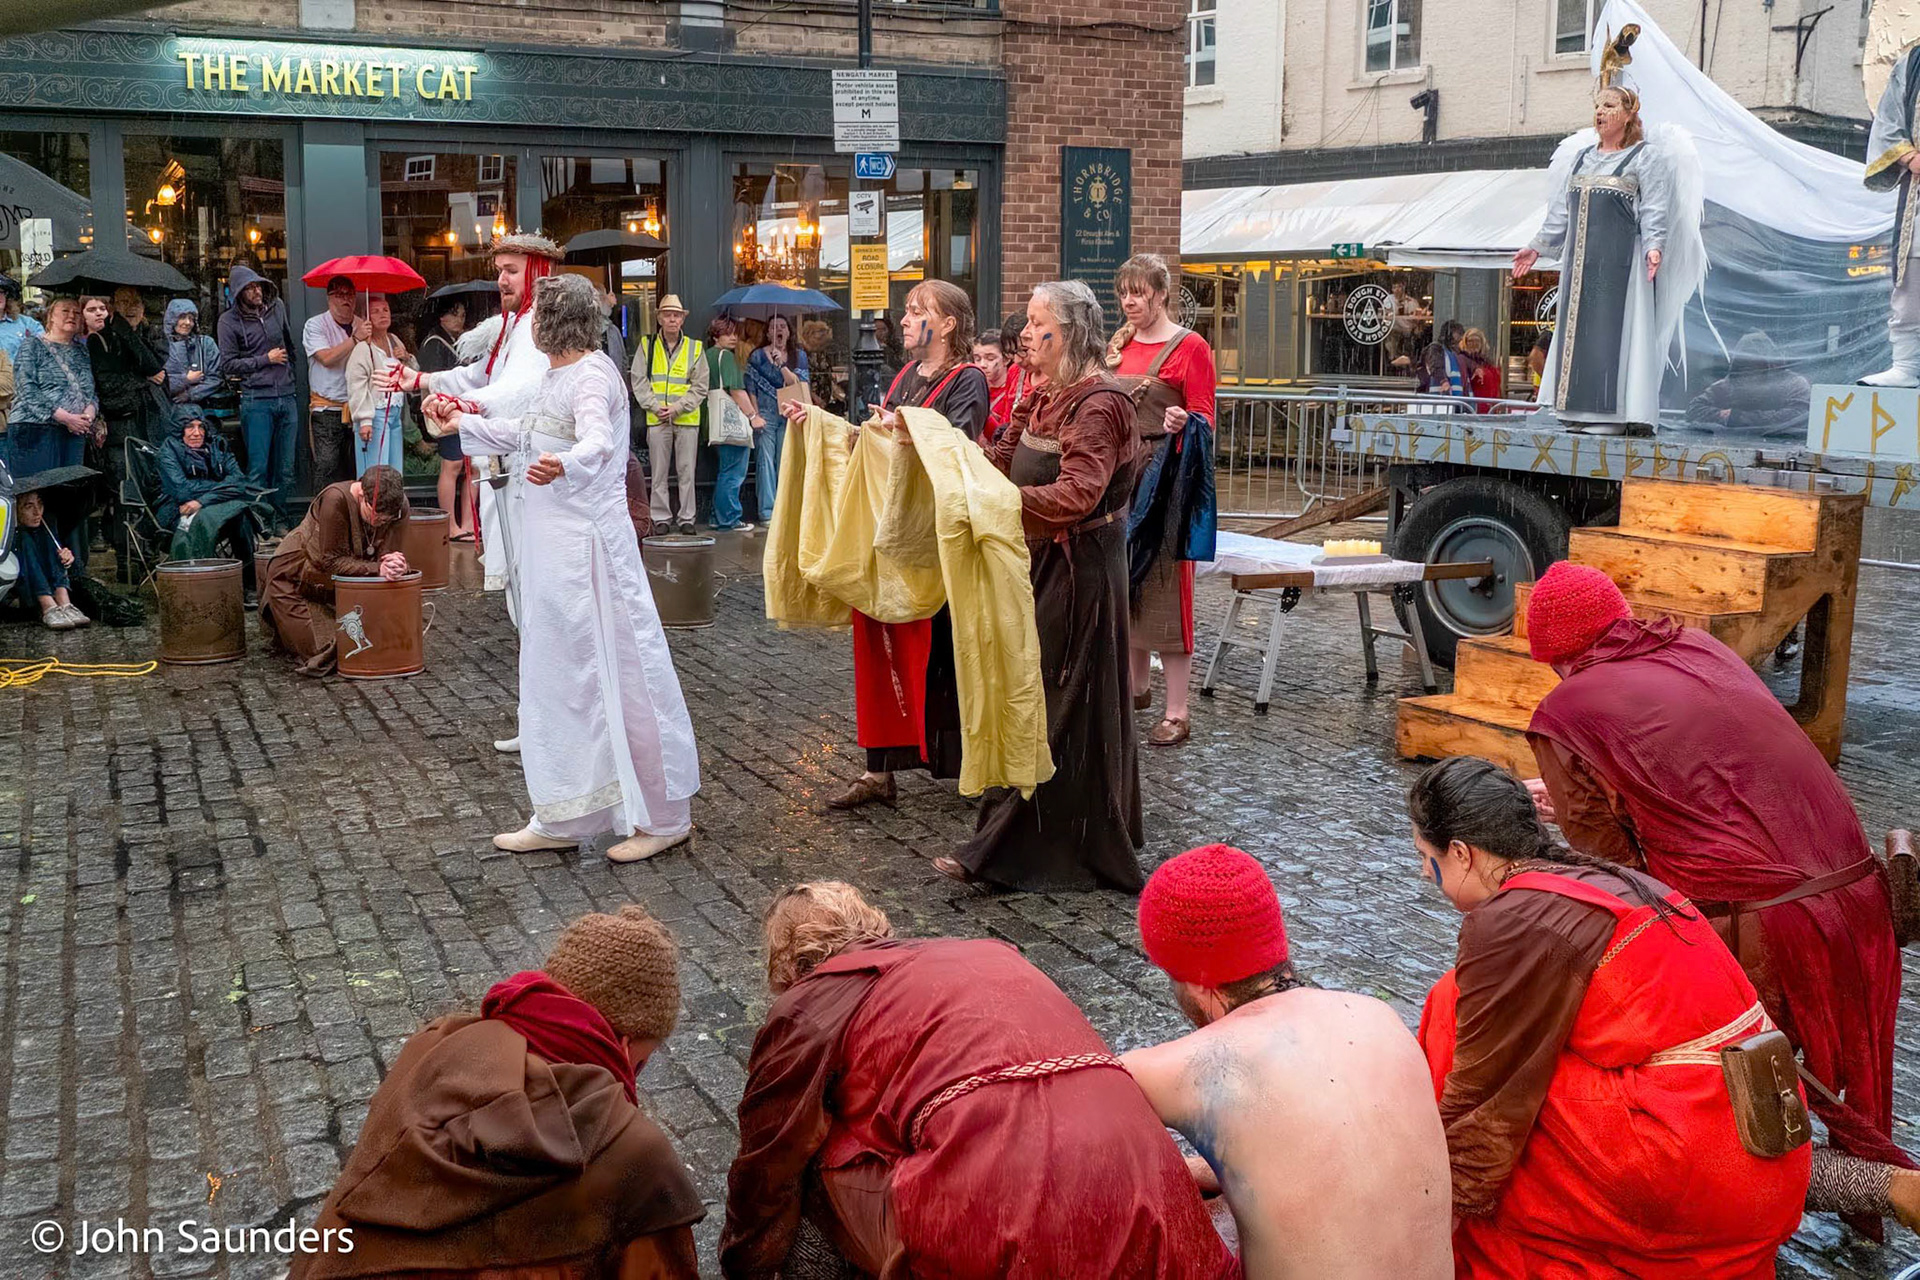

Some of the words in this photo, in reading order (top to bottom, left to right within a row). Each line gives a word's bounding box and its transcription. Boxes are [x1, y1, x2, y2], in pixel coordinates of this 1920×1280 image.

[178, 52, 250, 92] THE
[261, 55, 406, 99] MARKET
[415, 64, 478, 101] CAT
[862, 109, 870, 118] M
[870, 161, 882, 170] WC
[1073, 163, 1123, 204] THORNBRIDGE
[1083, 207, 1091, 218] &
[1096, 209, 1110, 221] CO
[1075, 229, 1082, 237] 22
[1347, 287, 1373, 309] DOUGH
[1347, 319, 1363, 340] EYED
